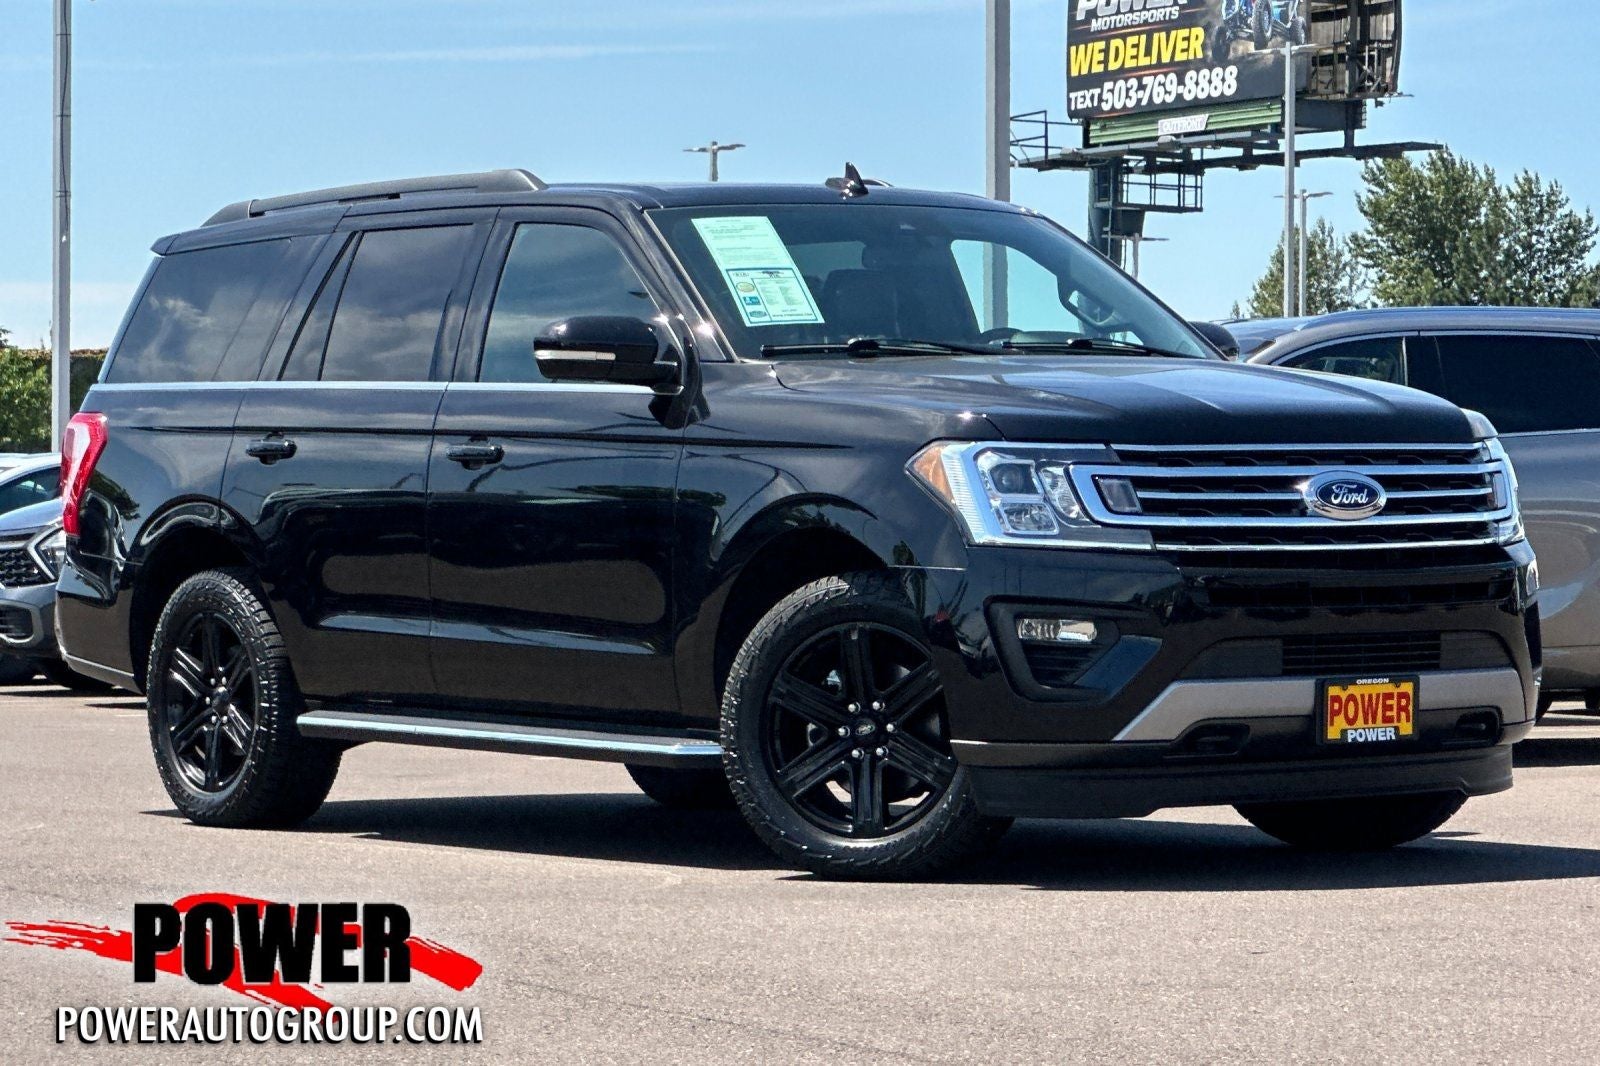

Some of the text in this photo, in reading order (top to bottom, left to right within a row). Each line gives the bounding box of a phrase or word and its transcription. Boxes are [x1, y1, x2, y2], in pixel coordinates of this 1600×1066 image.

[1090, 6, 1180, 32] MOTORSPORTS
[1070, 27, 1205, 77] WE DELIVER
[1069, 65, 1238, 111] TEXT 503-769-8888
[1331, 483, 1369, 504] Ford
[1329, 691, 1411, 726] POWER
[1347, 727, 1396, 743] POWER
